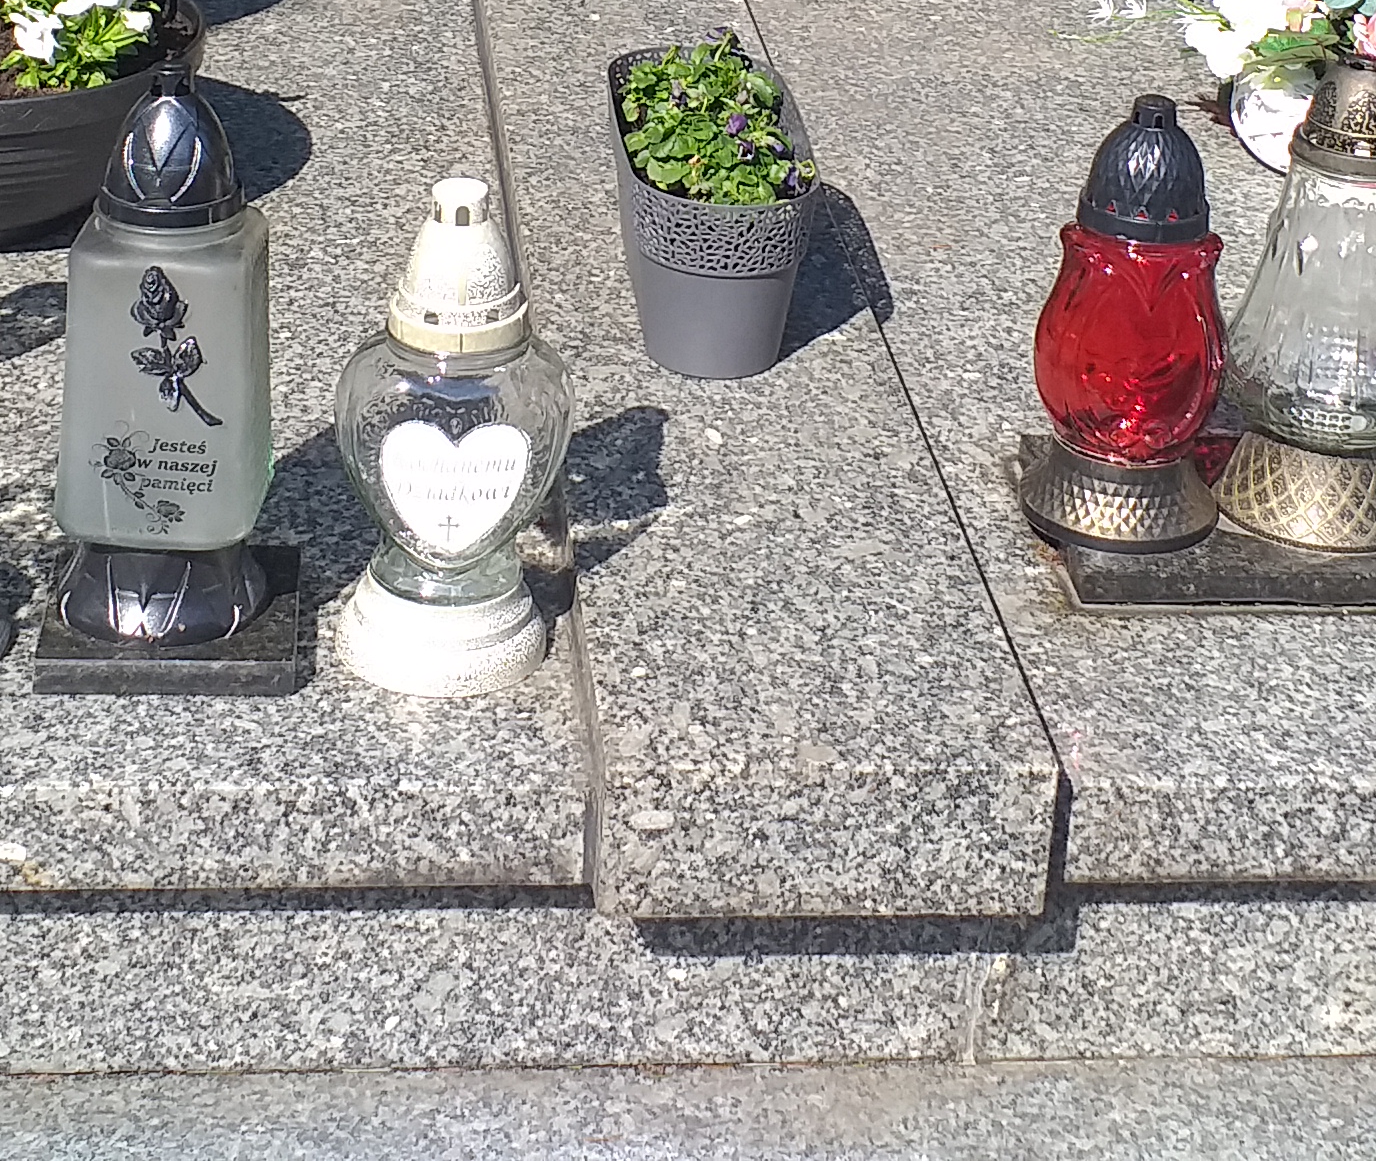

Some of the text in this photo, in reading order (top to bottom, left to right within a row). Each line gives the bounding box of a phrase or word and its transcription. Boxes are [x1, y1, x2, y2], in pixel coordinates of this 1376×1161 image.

[147, 438, 208, 455] Jesteś
[136, 458, 219, 478] w naszej
[138, 477, 214, 495] pamięci
